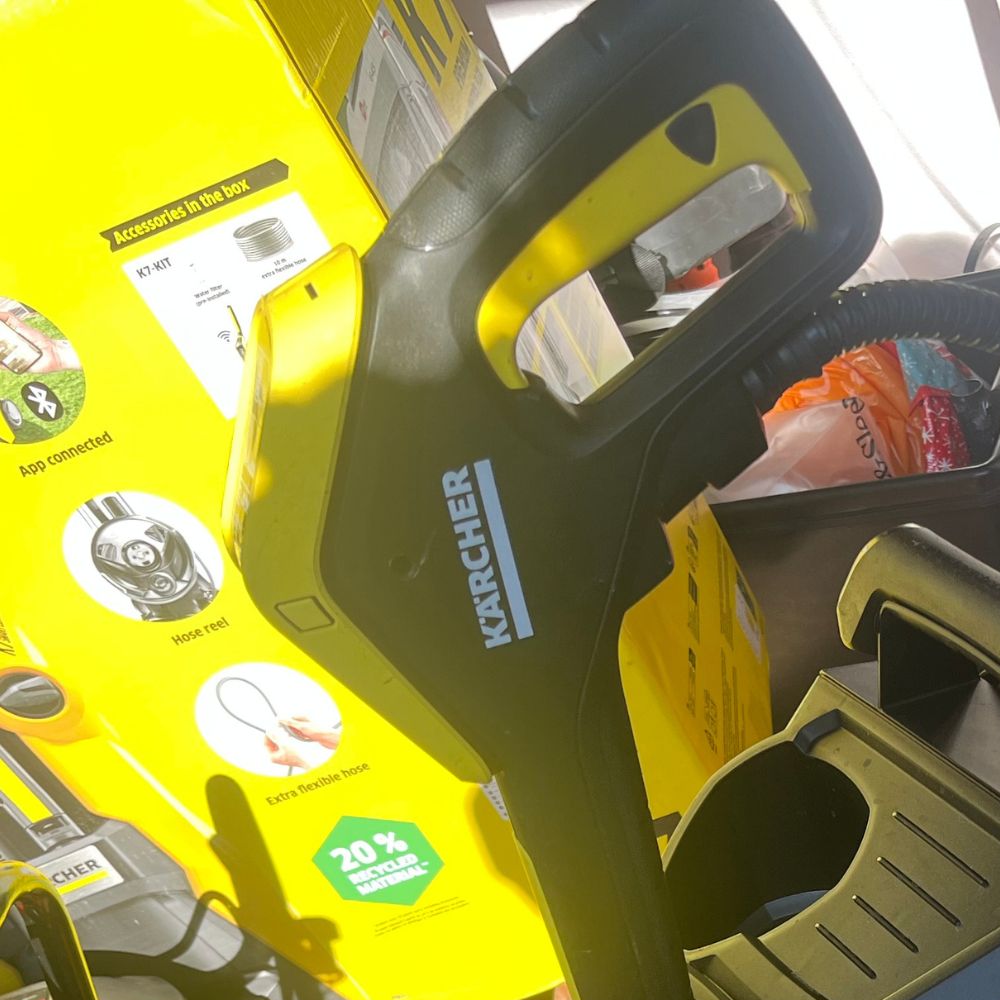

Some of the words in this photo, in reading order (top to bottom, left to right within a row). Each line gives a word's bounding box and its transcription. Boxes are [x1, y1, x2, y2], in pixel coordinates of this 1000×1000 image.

[112, 206, 187, 246] Accessories
[186, 199, 202, 216] in
[198, 191, 224, 212] the
[223, 178, 251, 200] box
[136, 256, 173, 280] K7-KIT
[18, 457, 48, 479] App
[47, 430, 115, 467] connected
[441, 464, 512, 650] KÄRCHER
[171, 626, 205, 647] Hose
[204, 616, 230, 635] reel
[265, 786, 298, 807] Extra
[297, 769, 342, 797] flexible
[342, 761, 371, 779] hose
[51, 859, 101, 886] CHER
[329, 839, 378, 873] 20
[372, 831, 409, 854] %
[347, 853, 419, 885] RECYCLED
